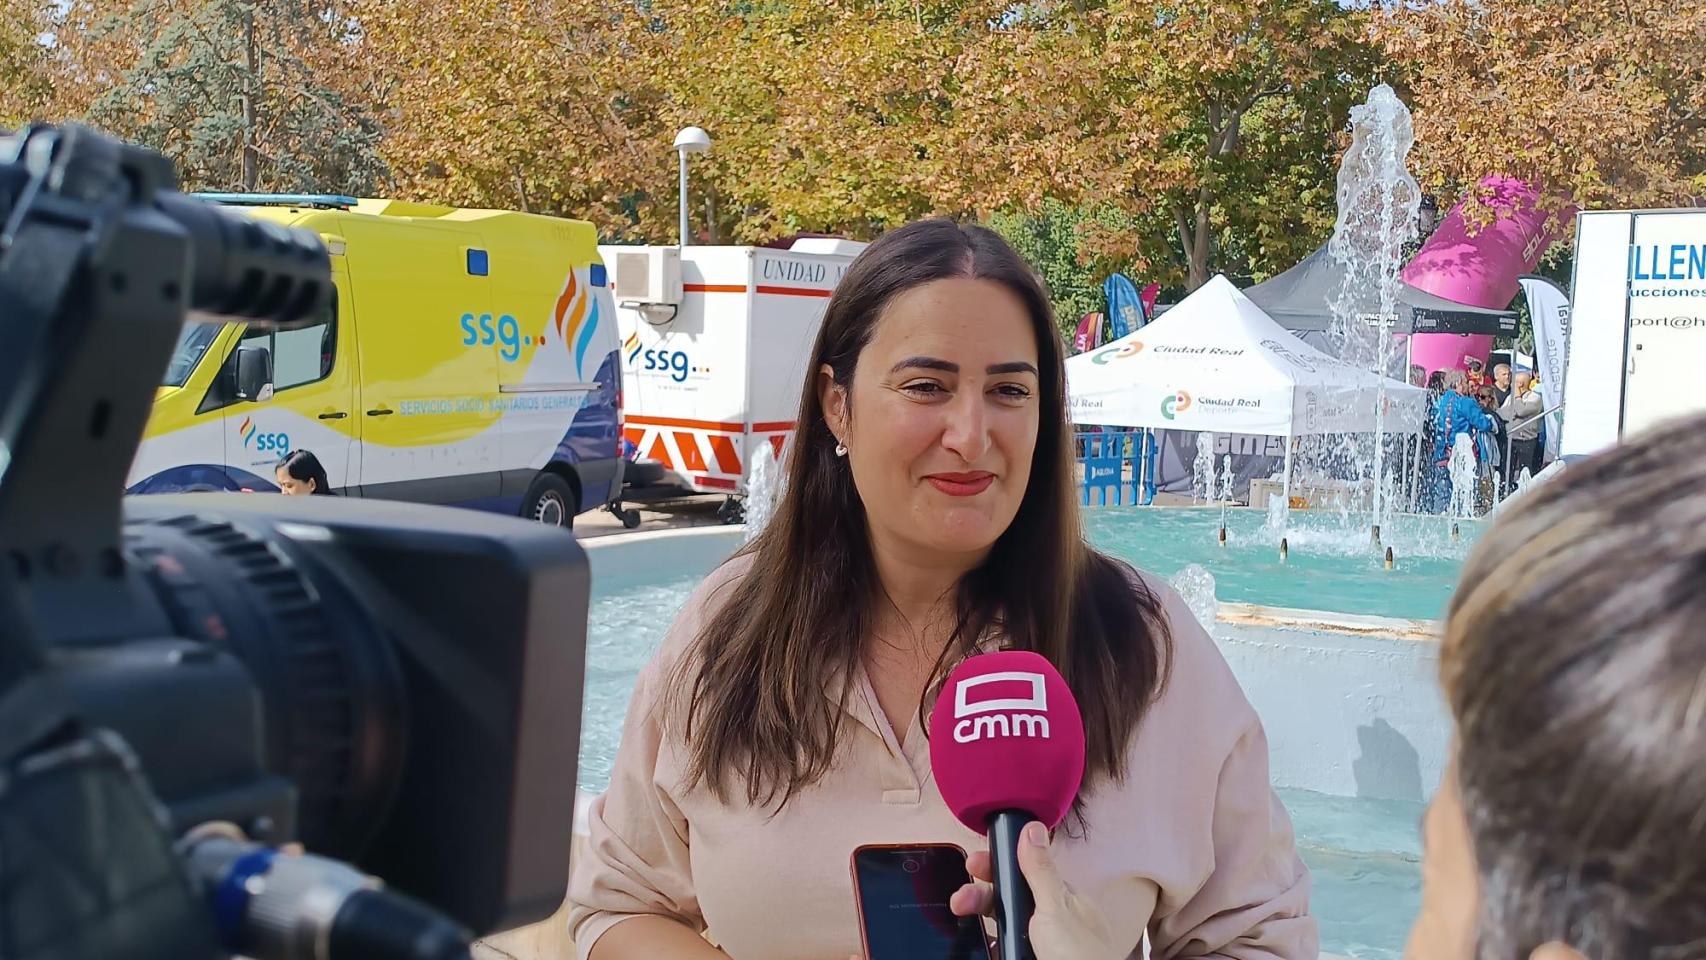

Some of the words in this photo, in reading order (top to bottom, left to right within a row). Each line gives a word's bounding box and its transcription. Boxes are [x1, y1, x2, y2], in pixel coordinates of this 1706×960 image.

[763, 259, 826, 282] UNIDAD
[1153, 344, 1206, 354] Ciudad
[1209, 346, 1244, 356] Real
[1081, 398, 1103, 408] Real
[1198, 396, 1235, 407] Ciudad
[1237, 398, 1261, 408] Real
[256, 432, 289, 458] ssg
[953, 713, 1050, 743] cmm
